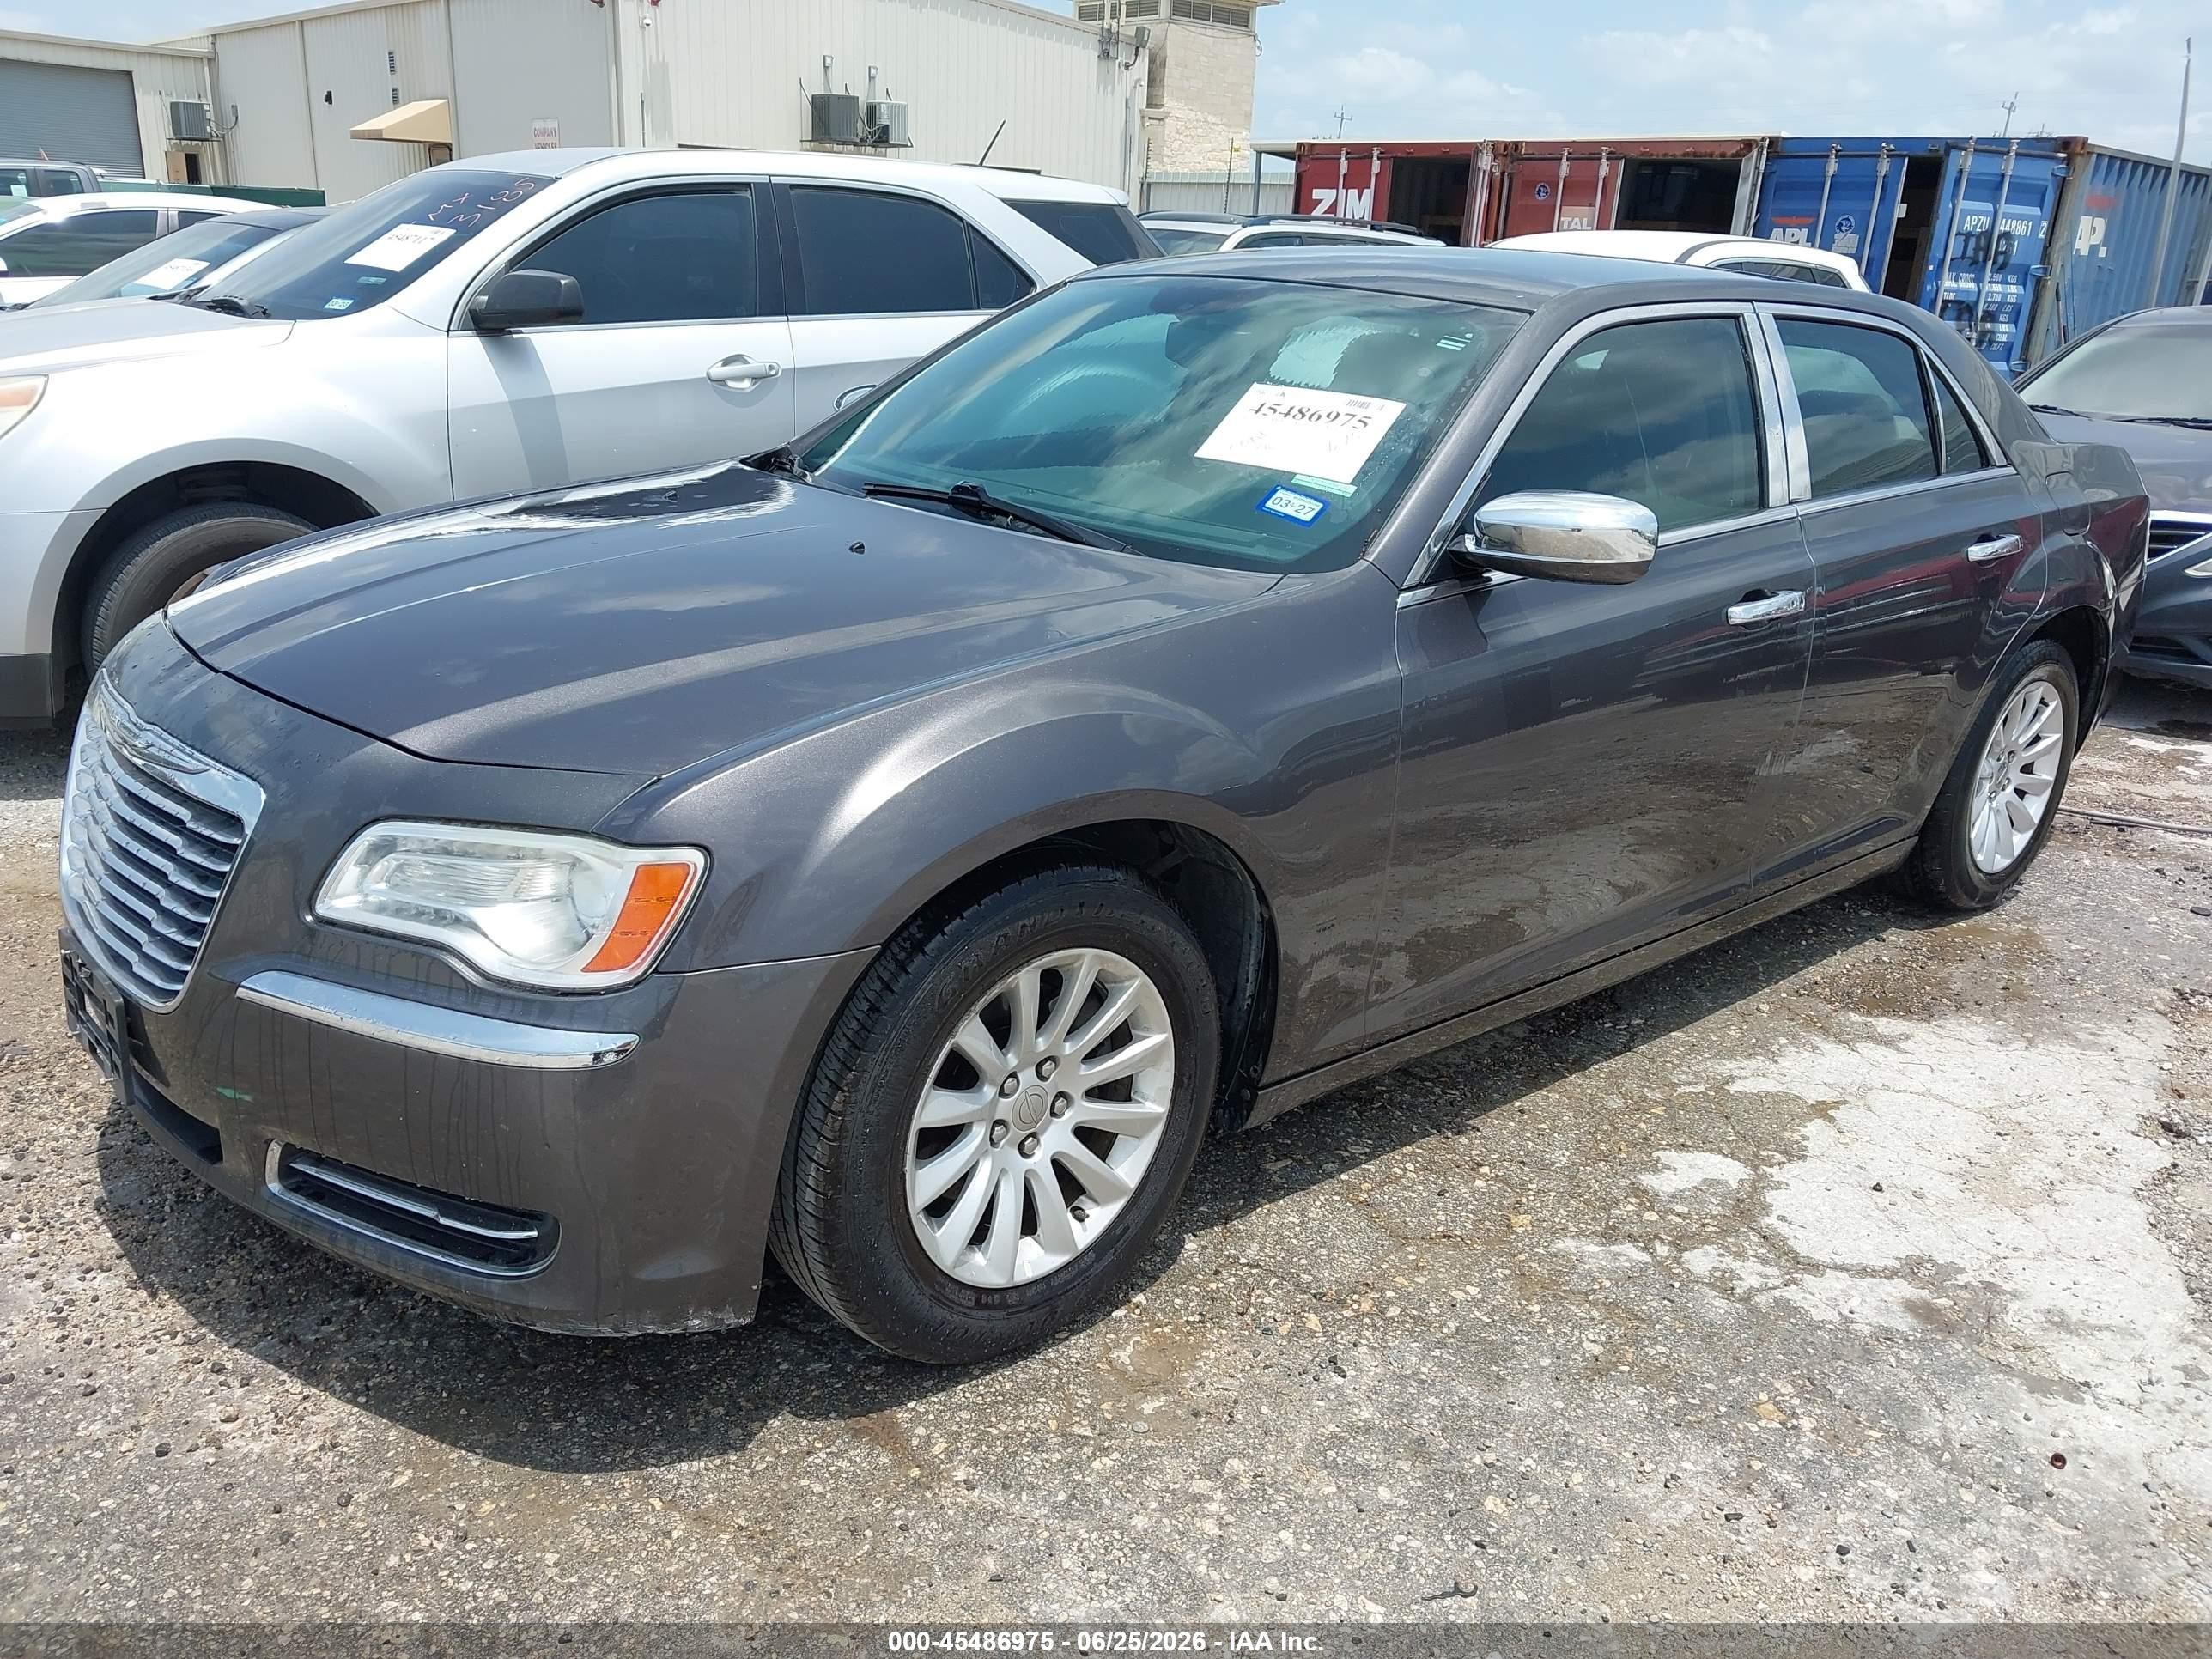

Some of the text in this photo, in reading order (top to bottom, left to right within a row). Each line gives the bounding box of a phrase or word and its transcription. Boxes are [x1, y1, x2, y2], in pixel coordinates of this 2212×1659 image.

[1310, 188, 1371, 222] ZIM
[1560, 216, 1593, 231] TAL
[1963, 215, 1990, 232] APZU
[1770, 228, 1812, 247] APL
[1249, 402, 1372, 430] 45486975
